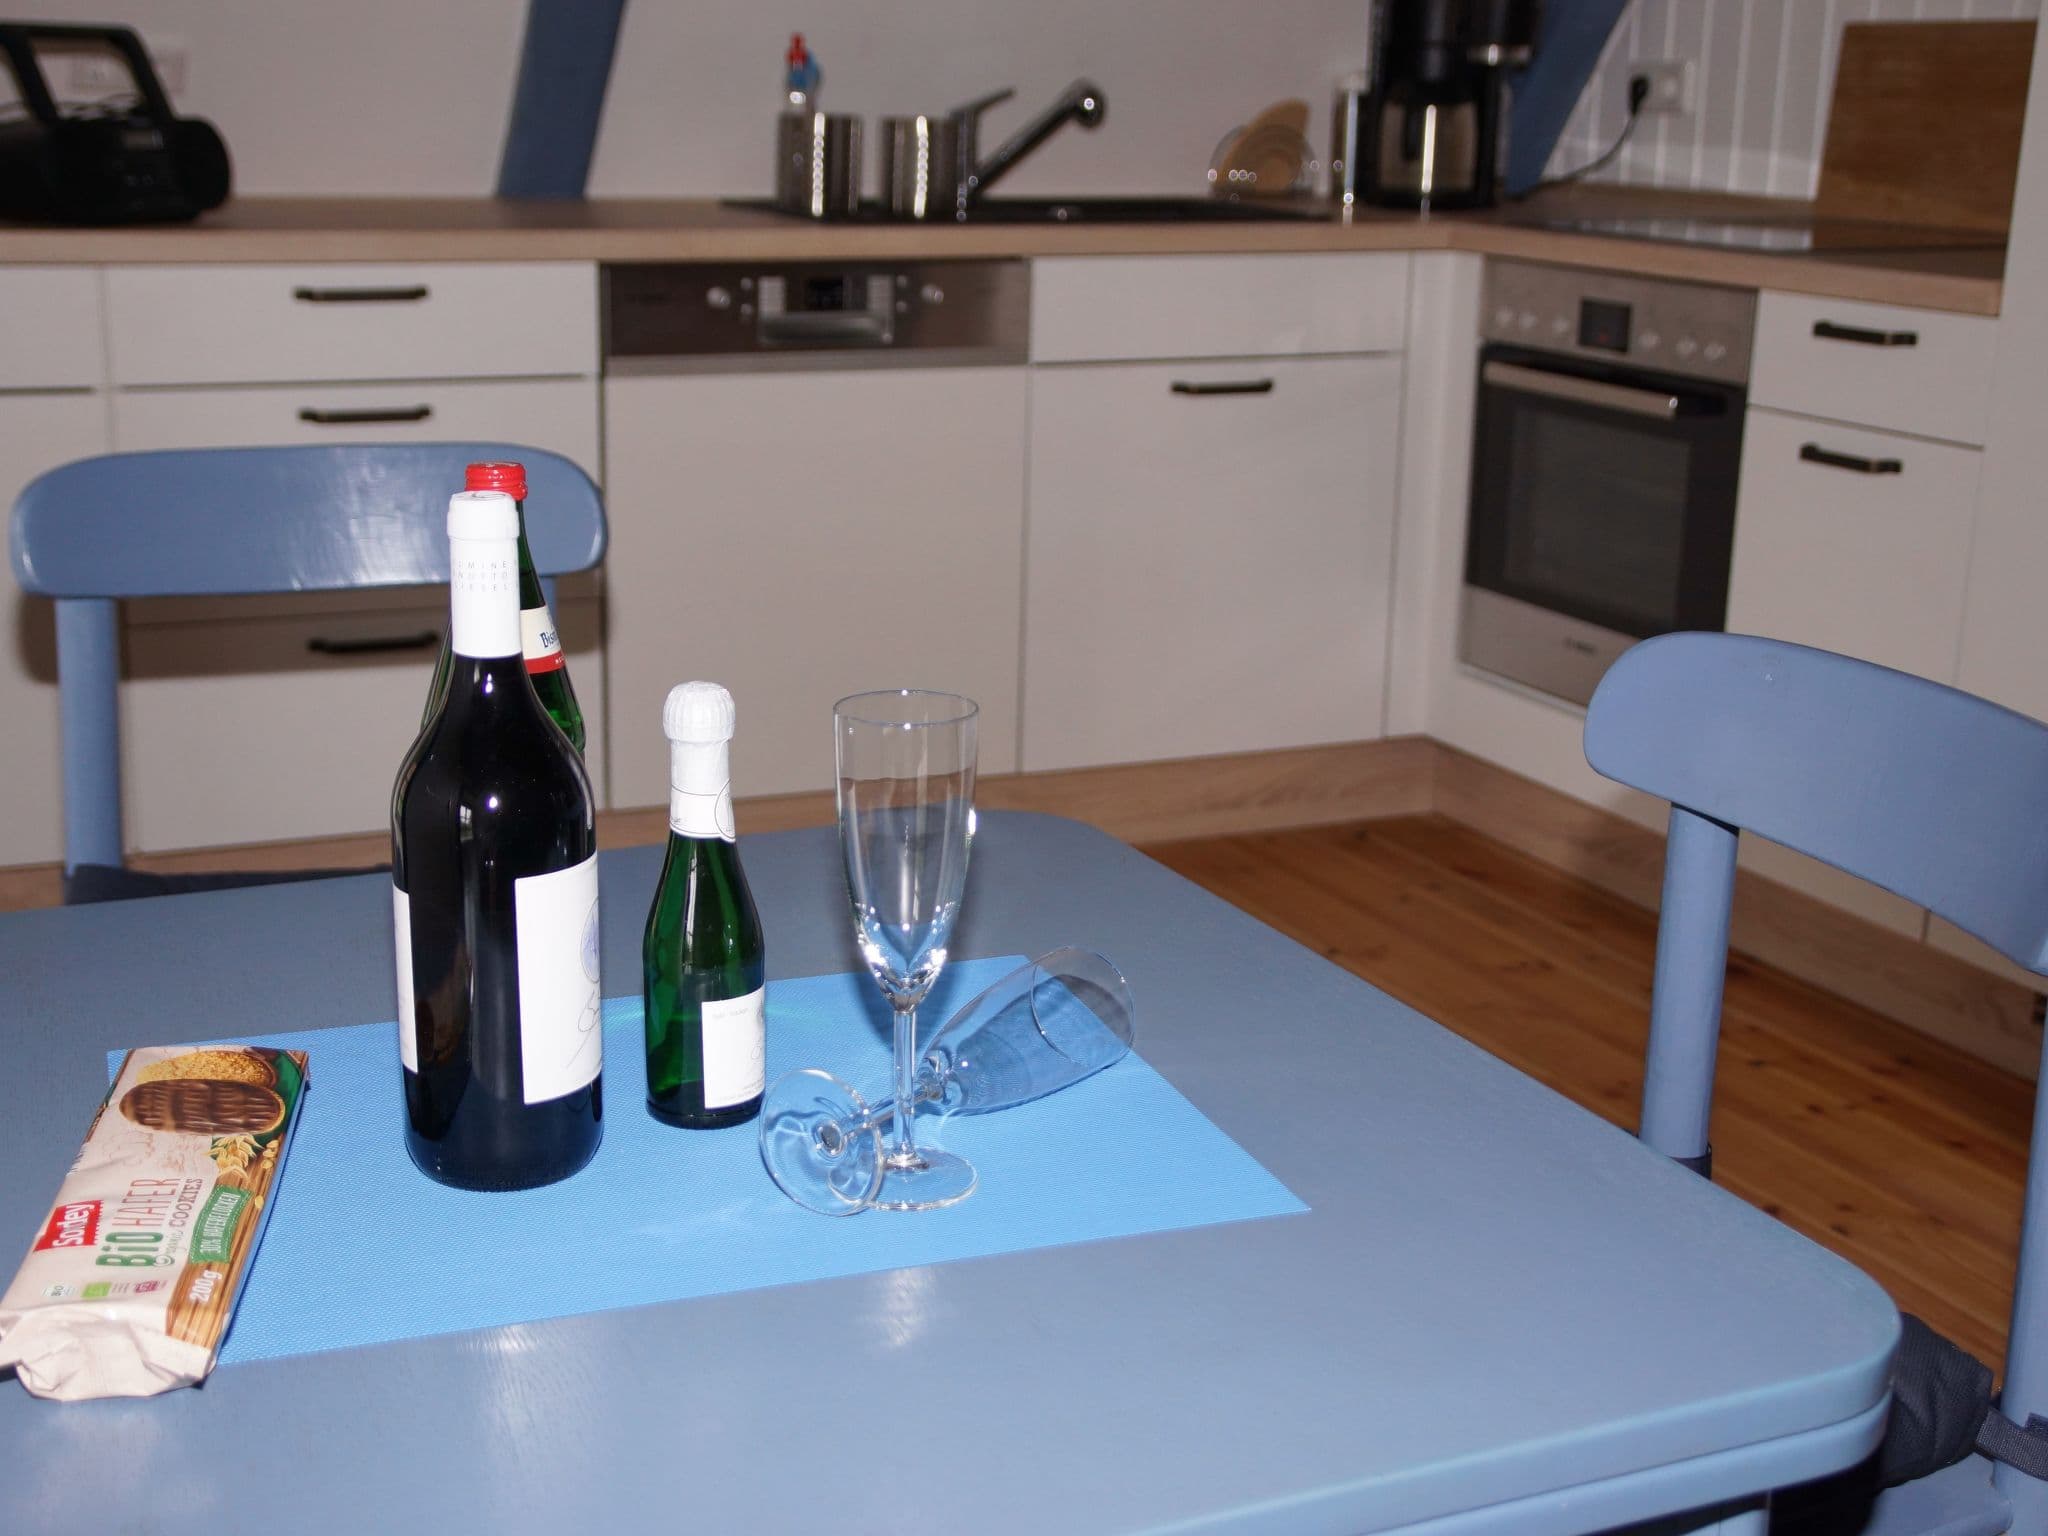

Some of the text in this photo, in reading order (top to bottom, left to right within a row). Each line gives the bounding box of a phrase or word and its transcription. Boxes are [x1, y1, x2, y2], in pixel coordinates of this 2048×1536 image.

[111, 1178, 182, 1227] HAFER
[168, 1178, 204, 1228] COOKIES
[188, 1269, 223, 1303] 200g
